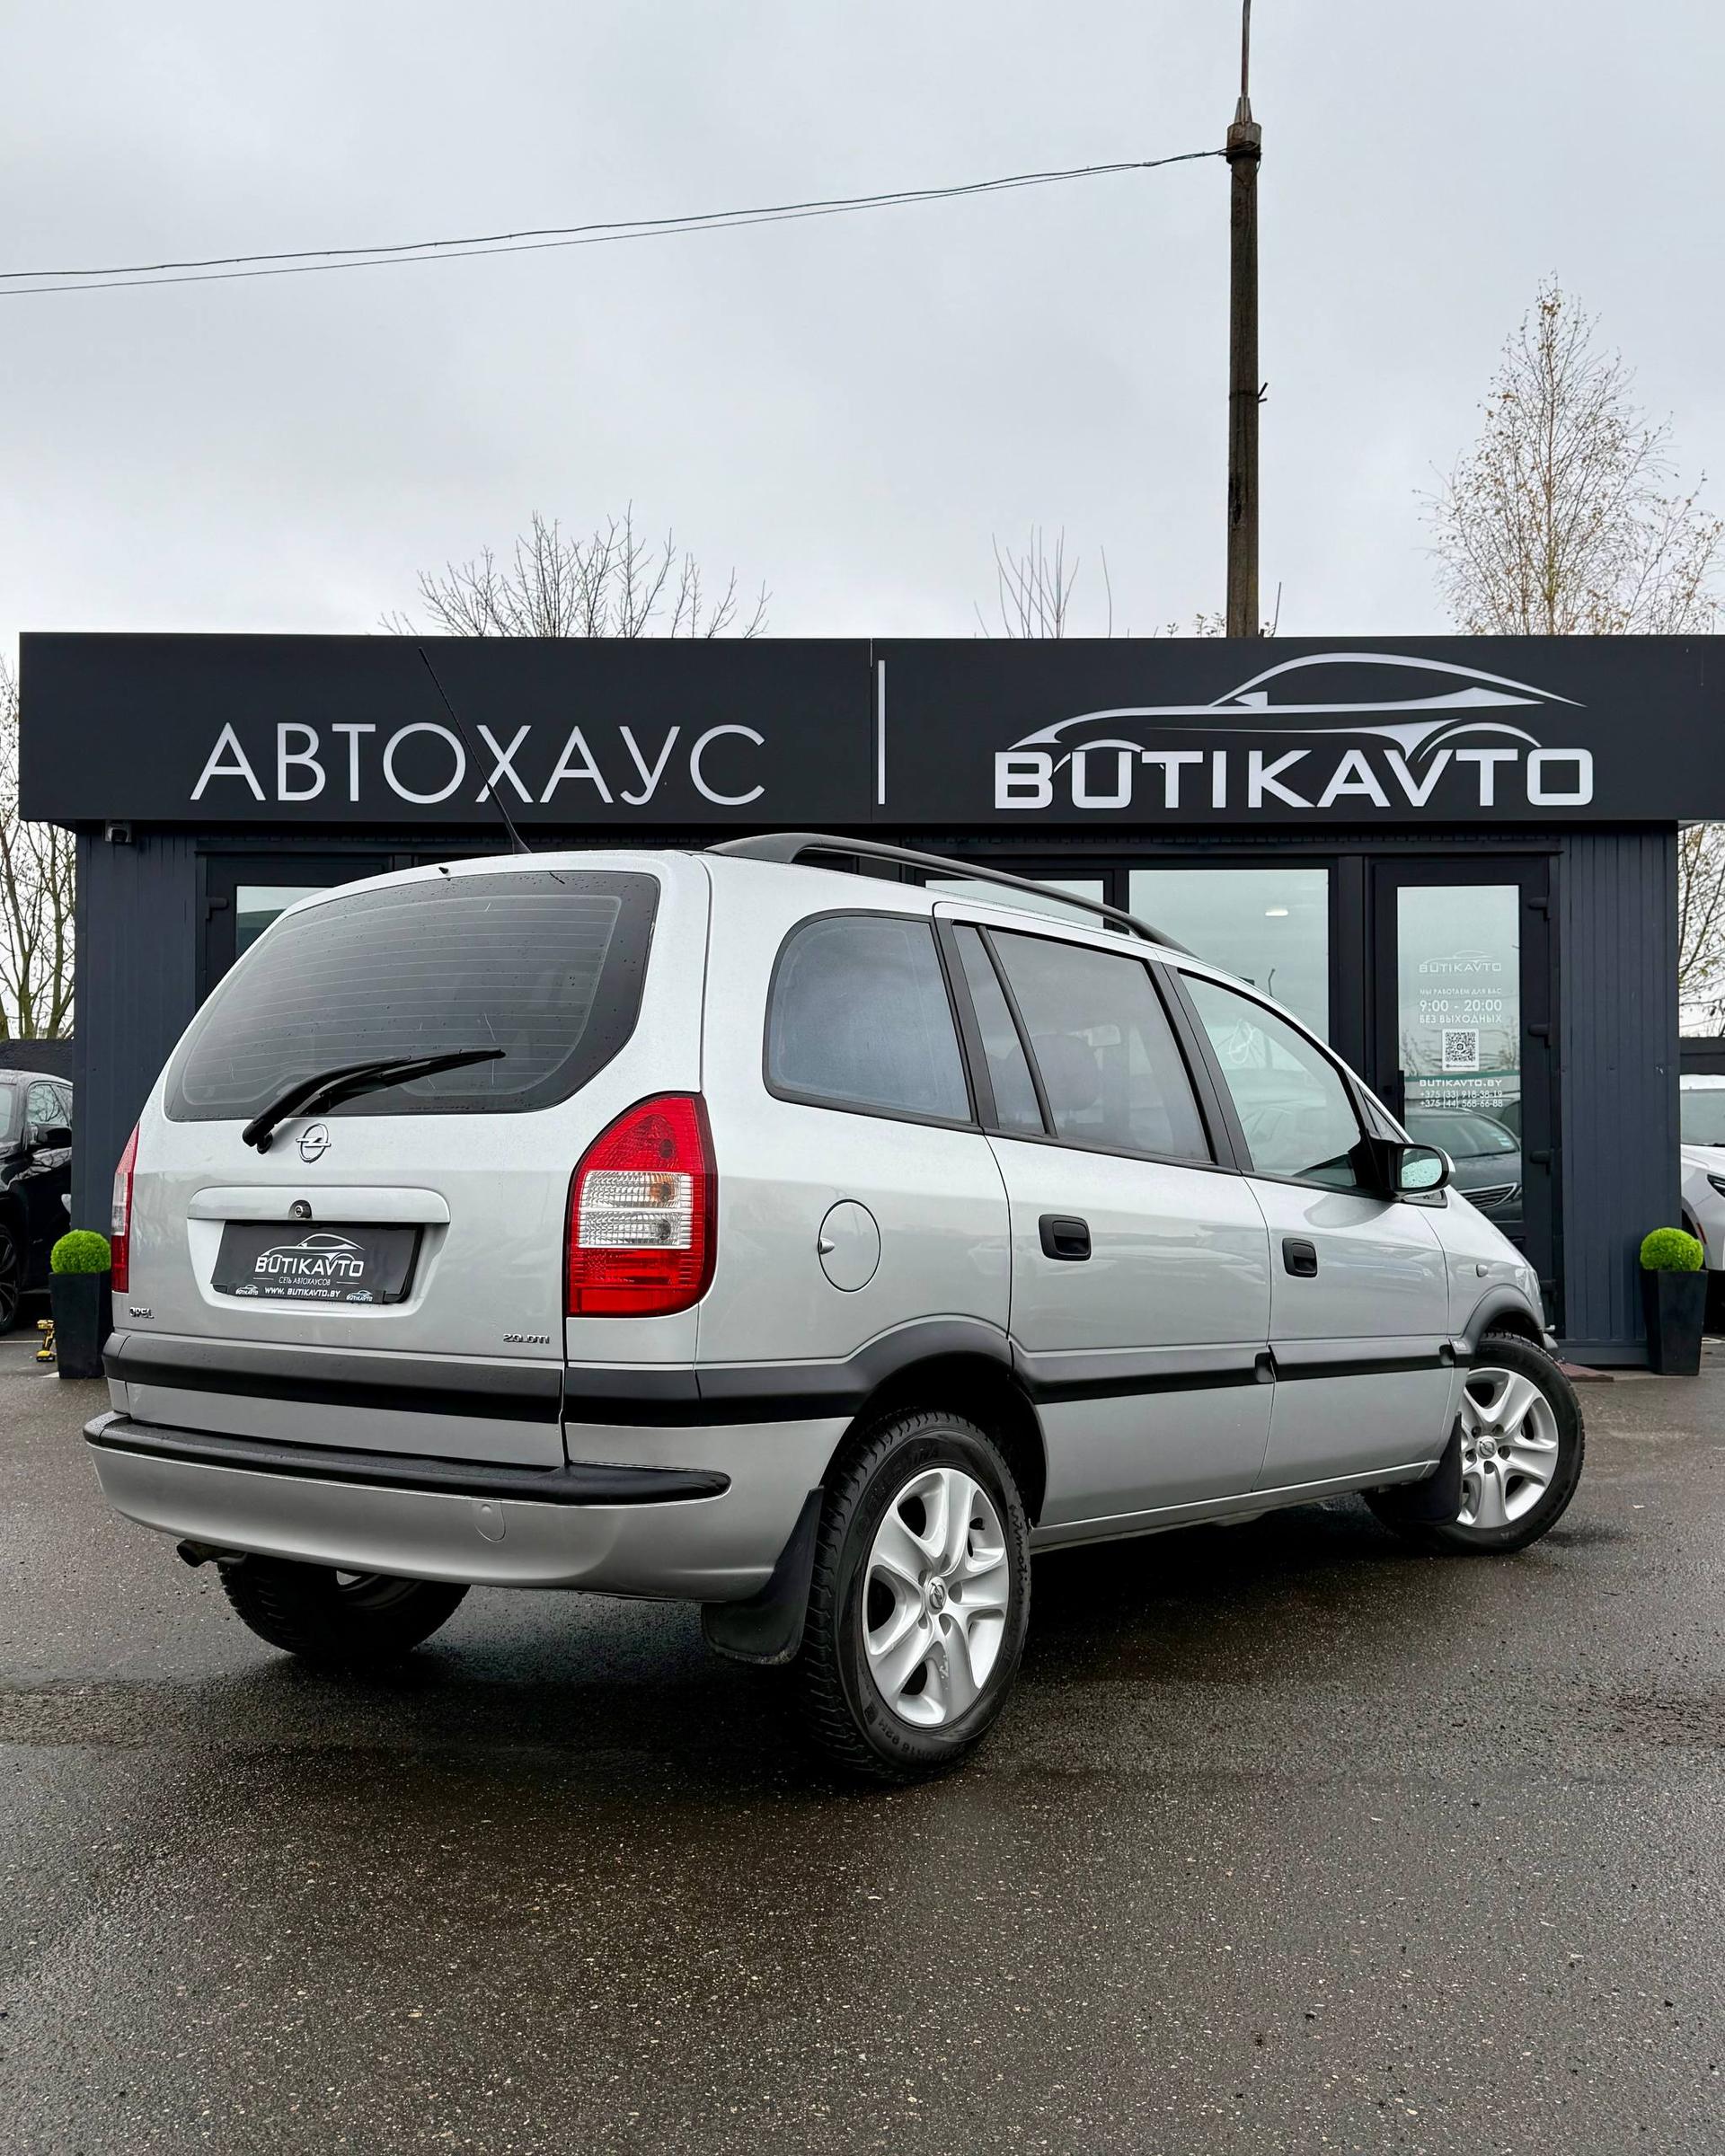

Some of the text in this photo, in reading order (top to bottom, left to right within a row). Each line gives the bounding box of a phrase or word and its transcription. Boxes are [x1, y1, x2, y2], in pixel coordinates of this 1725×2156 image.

[190, 721, 766, 807] АВТОХАУС
[994, 747, 1595, 809] BUTIKAVTO
[1420, 962, 1501, 972] BUTIKAVTO
[1420, 1000, 1448, 1012] 9:00
[1464, 999, 1502, 1012] 20:00
[1420, 1014, 1502, 1023] БЕЗ ВЫХОДНЫХ
[1420, 1079, 1502, 1087] BUTIKAVTO.BY
[1420, 1090, 1441, 1098] +375
[1420, 1100, 1441, 1108] +375
[254, 1257, 364, 1277] BUTIKAVTO
[287, 1287, 341, 1298] BUTIKAVTO.BY
[129, 1306, 155, 1319] OPEL
